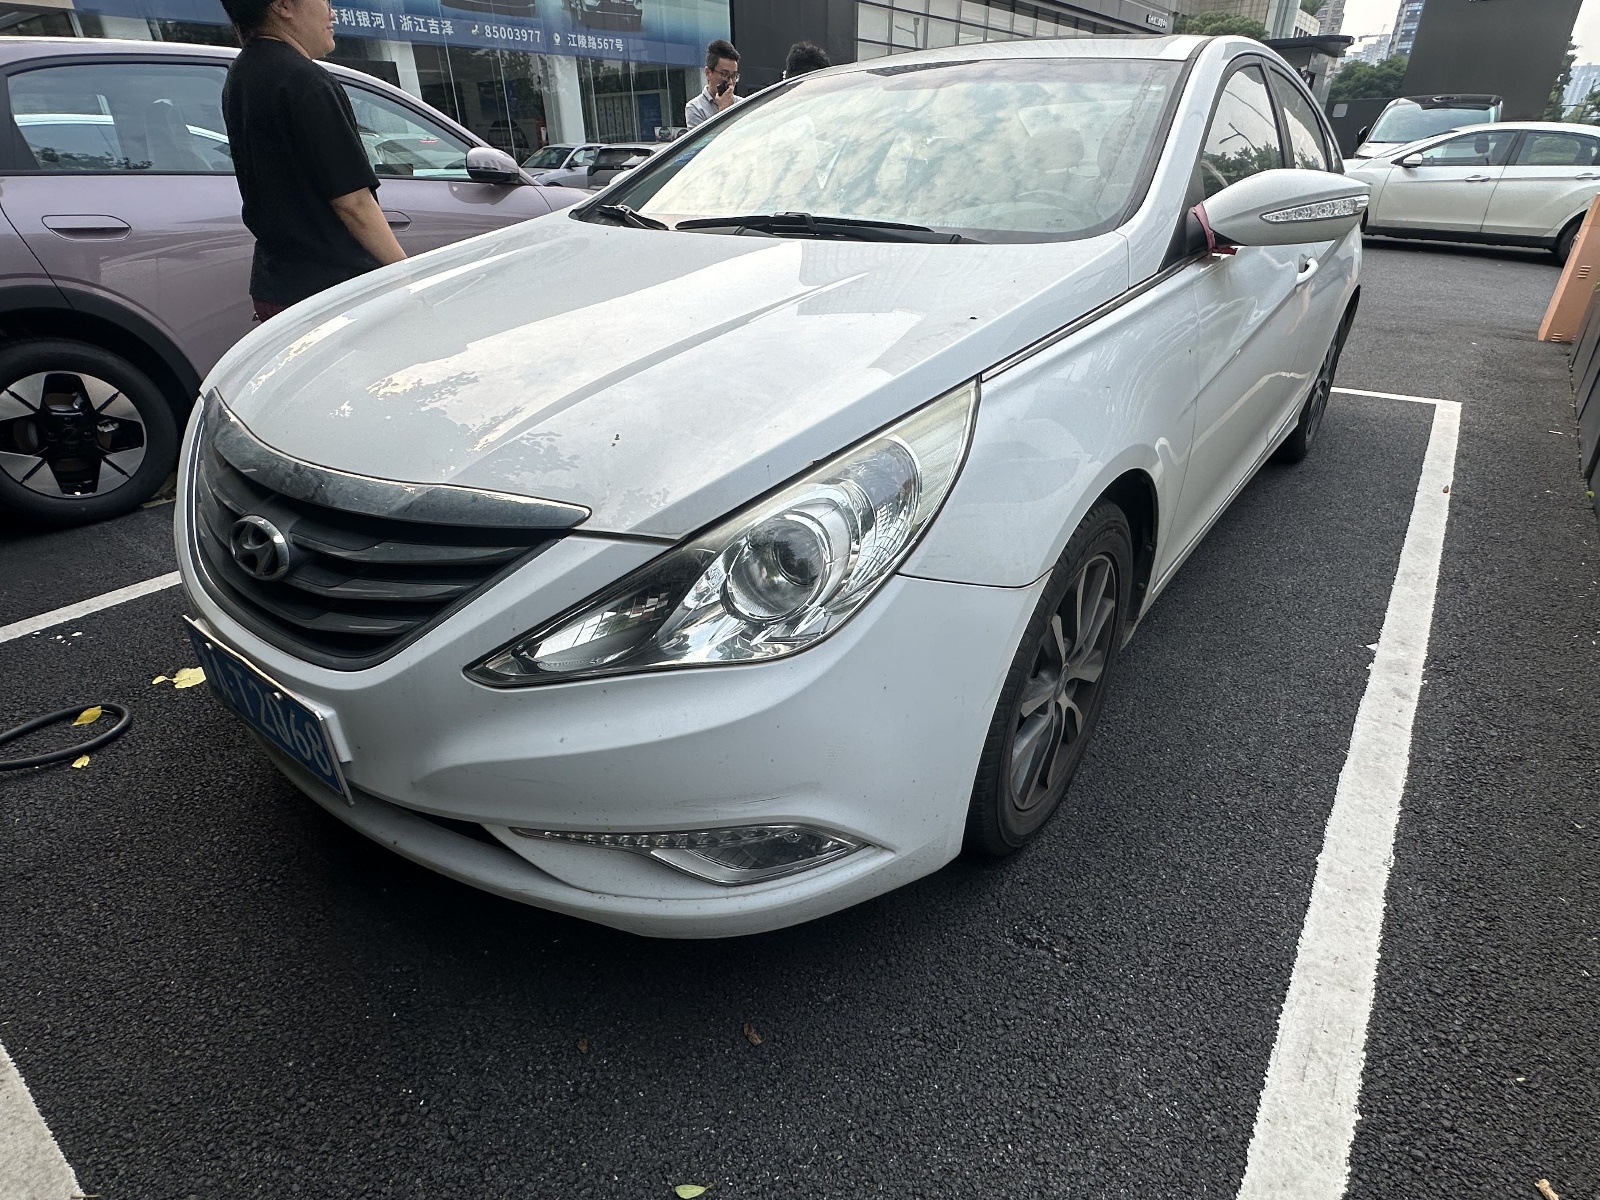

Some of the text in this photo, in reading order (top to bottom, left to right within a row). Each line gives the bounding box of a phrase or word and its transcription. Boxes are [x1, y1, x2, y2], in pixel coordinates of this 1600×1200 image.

[399, 15, 454, 36] 浙江吉泽
[484, 24, 541, 43] 85003977
[567, 33, 624, 52] 江陵路567号
